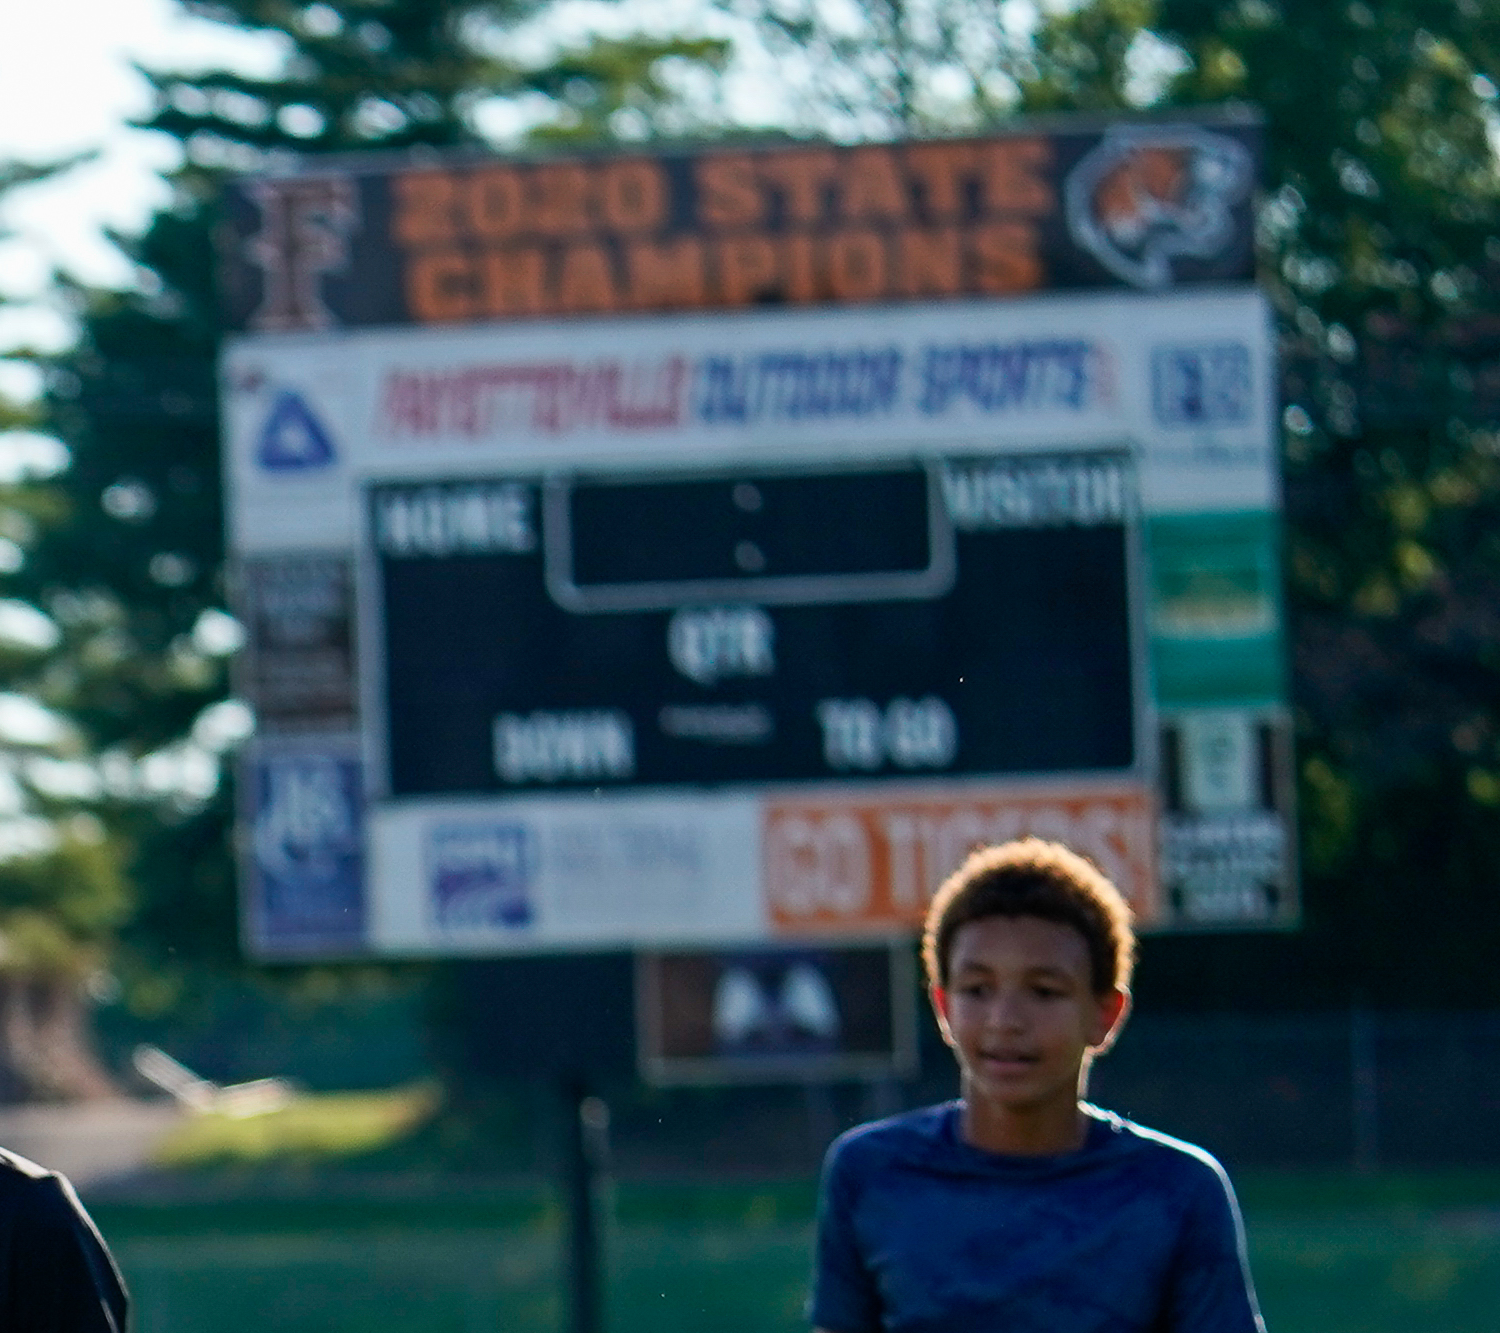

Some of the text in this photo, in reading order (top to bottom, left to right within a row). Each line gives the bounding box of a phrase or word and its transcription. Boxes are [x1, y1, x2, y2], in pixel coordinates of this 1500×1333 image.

[390, 139, 1056, 245] 2020 STATE
[406, 221, 1046, 324] CHAMPIONS
[377, 462, 1125, 556] HOME VISITOR
[667, 602, 777, 686] QTR
[493, 708, 638, 780] DOWN
[817, 696, 881, 774] TO
[883, 694, 959, 770] GO
[772, 812, 872, 916] GO
